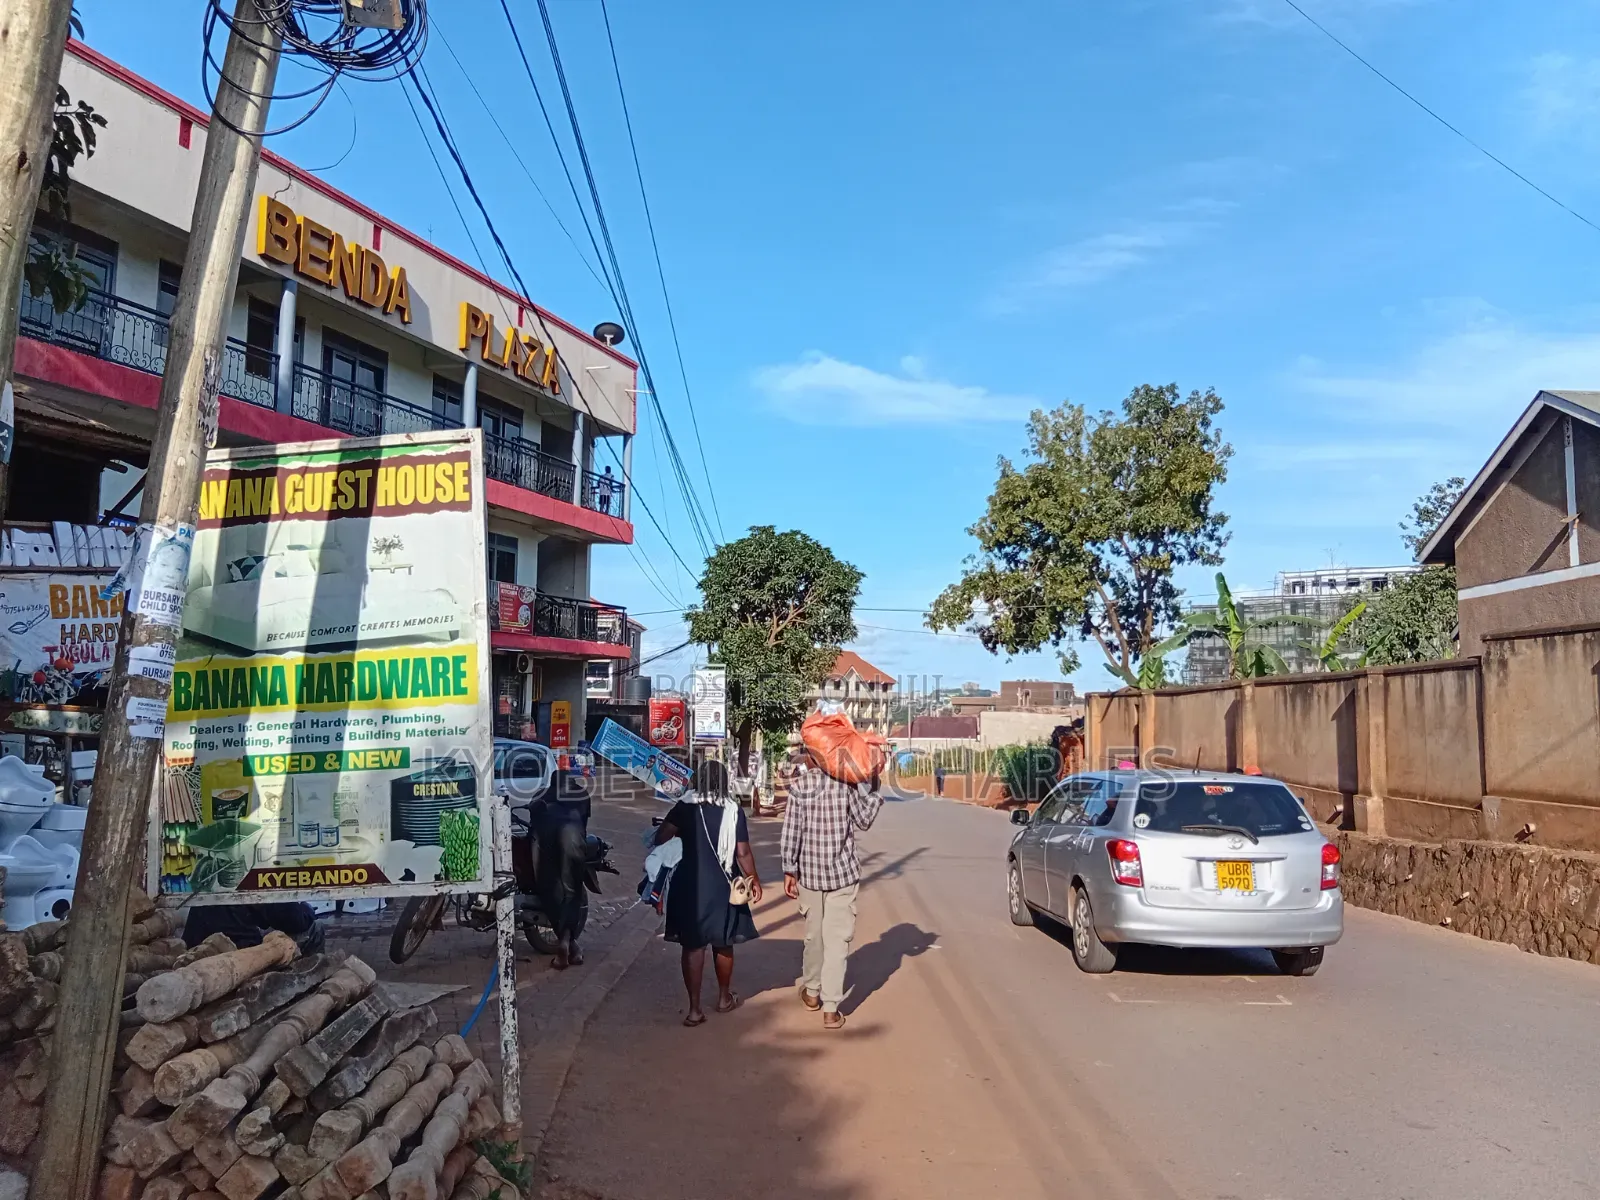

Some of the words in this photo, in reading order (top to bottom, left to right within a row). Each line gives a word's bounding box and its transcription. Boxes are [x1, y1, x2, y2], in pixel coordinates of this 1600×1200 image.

[257, 195, 413, 325] BENDA
[459, 301, 560, 395] PLAZA
[285, 468, 374, 515] GUEST
[376, 461, 471, 507] HOUSE
[140, 599, 168, 612] CHILD
[143, 590, 181, 605] BURSARY
[266, 630, 306, 643] BECAUSE
[310, 624, 357, 637] COMFORT
[360, 620, 400, 632] CREATES
[402, 614, 455, 628] MEMORIES
[173, 664, 290, 712] BANANA
[294, 655, 469, 705] HARDWARE
[189, 723, 235, 735] Dealers
[238, 722, 253, 734] In:
[256, 719, 307, 732] General
[310, 715, 378, 730] Hardware,
[381, 711, 446, 727] Plumbing,
[172, 738, 219, 751] Roofing,
[222, 735, 274, 750] Welding,
[277, 731, 330, 746] Painting
[334, 732, 345, 743] &
[348, 728, 402, 744] Building
[405, 725, 466, 738] Materials
[254, 752, 317, 775] USED
[323, 751, 341, 770] &
[348, 749, 403, 770] NEW
[412, 781, 460, 797] CRESTANK
[257, 867, 369, 888] KYEBANDO
[1227, 863, 1250, 876] UBR
[1221, 877, 1251, 890] 597Q
